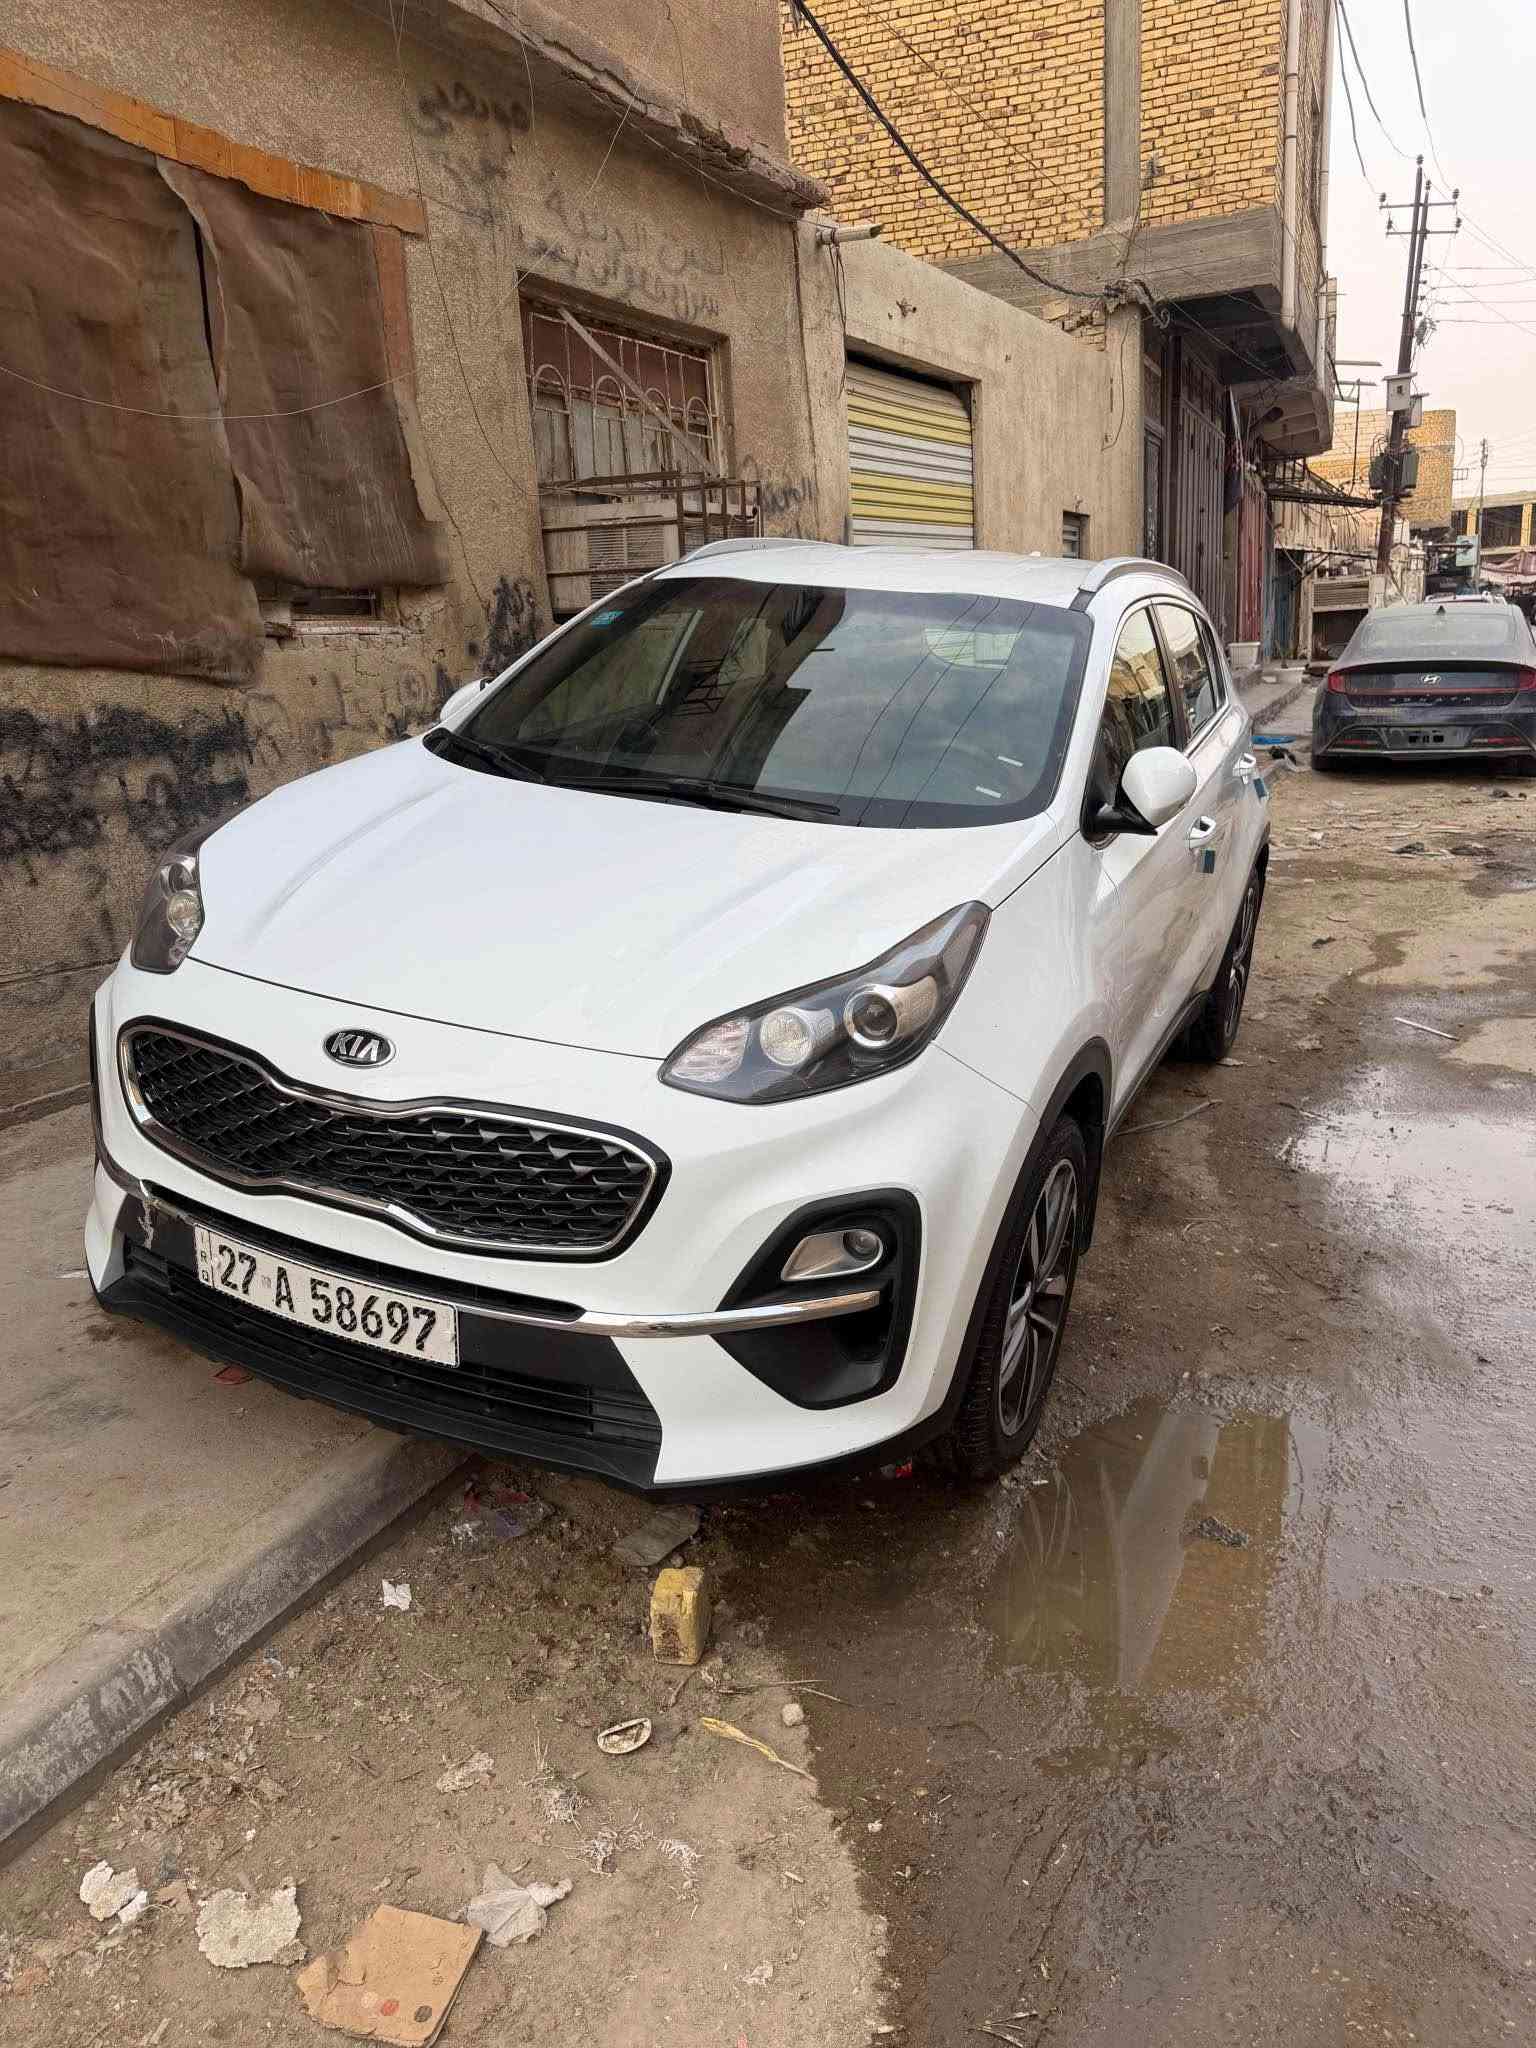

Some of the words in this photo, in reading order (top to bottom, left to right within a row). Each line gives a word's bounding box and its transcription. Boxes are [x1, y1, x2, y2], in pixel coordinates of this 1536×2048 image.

[330, 1032, 380, 1062] KIA
[218, 1244, 257, 1294] 27
[275, 1266, 295, 1314] A
[310, 1278, 436, 1350] 58697
